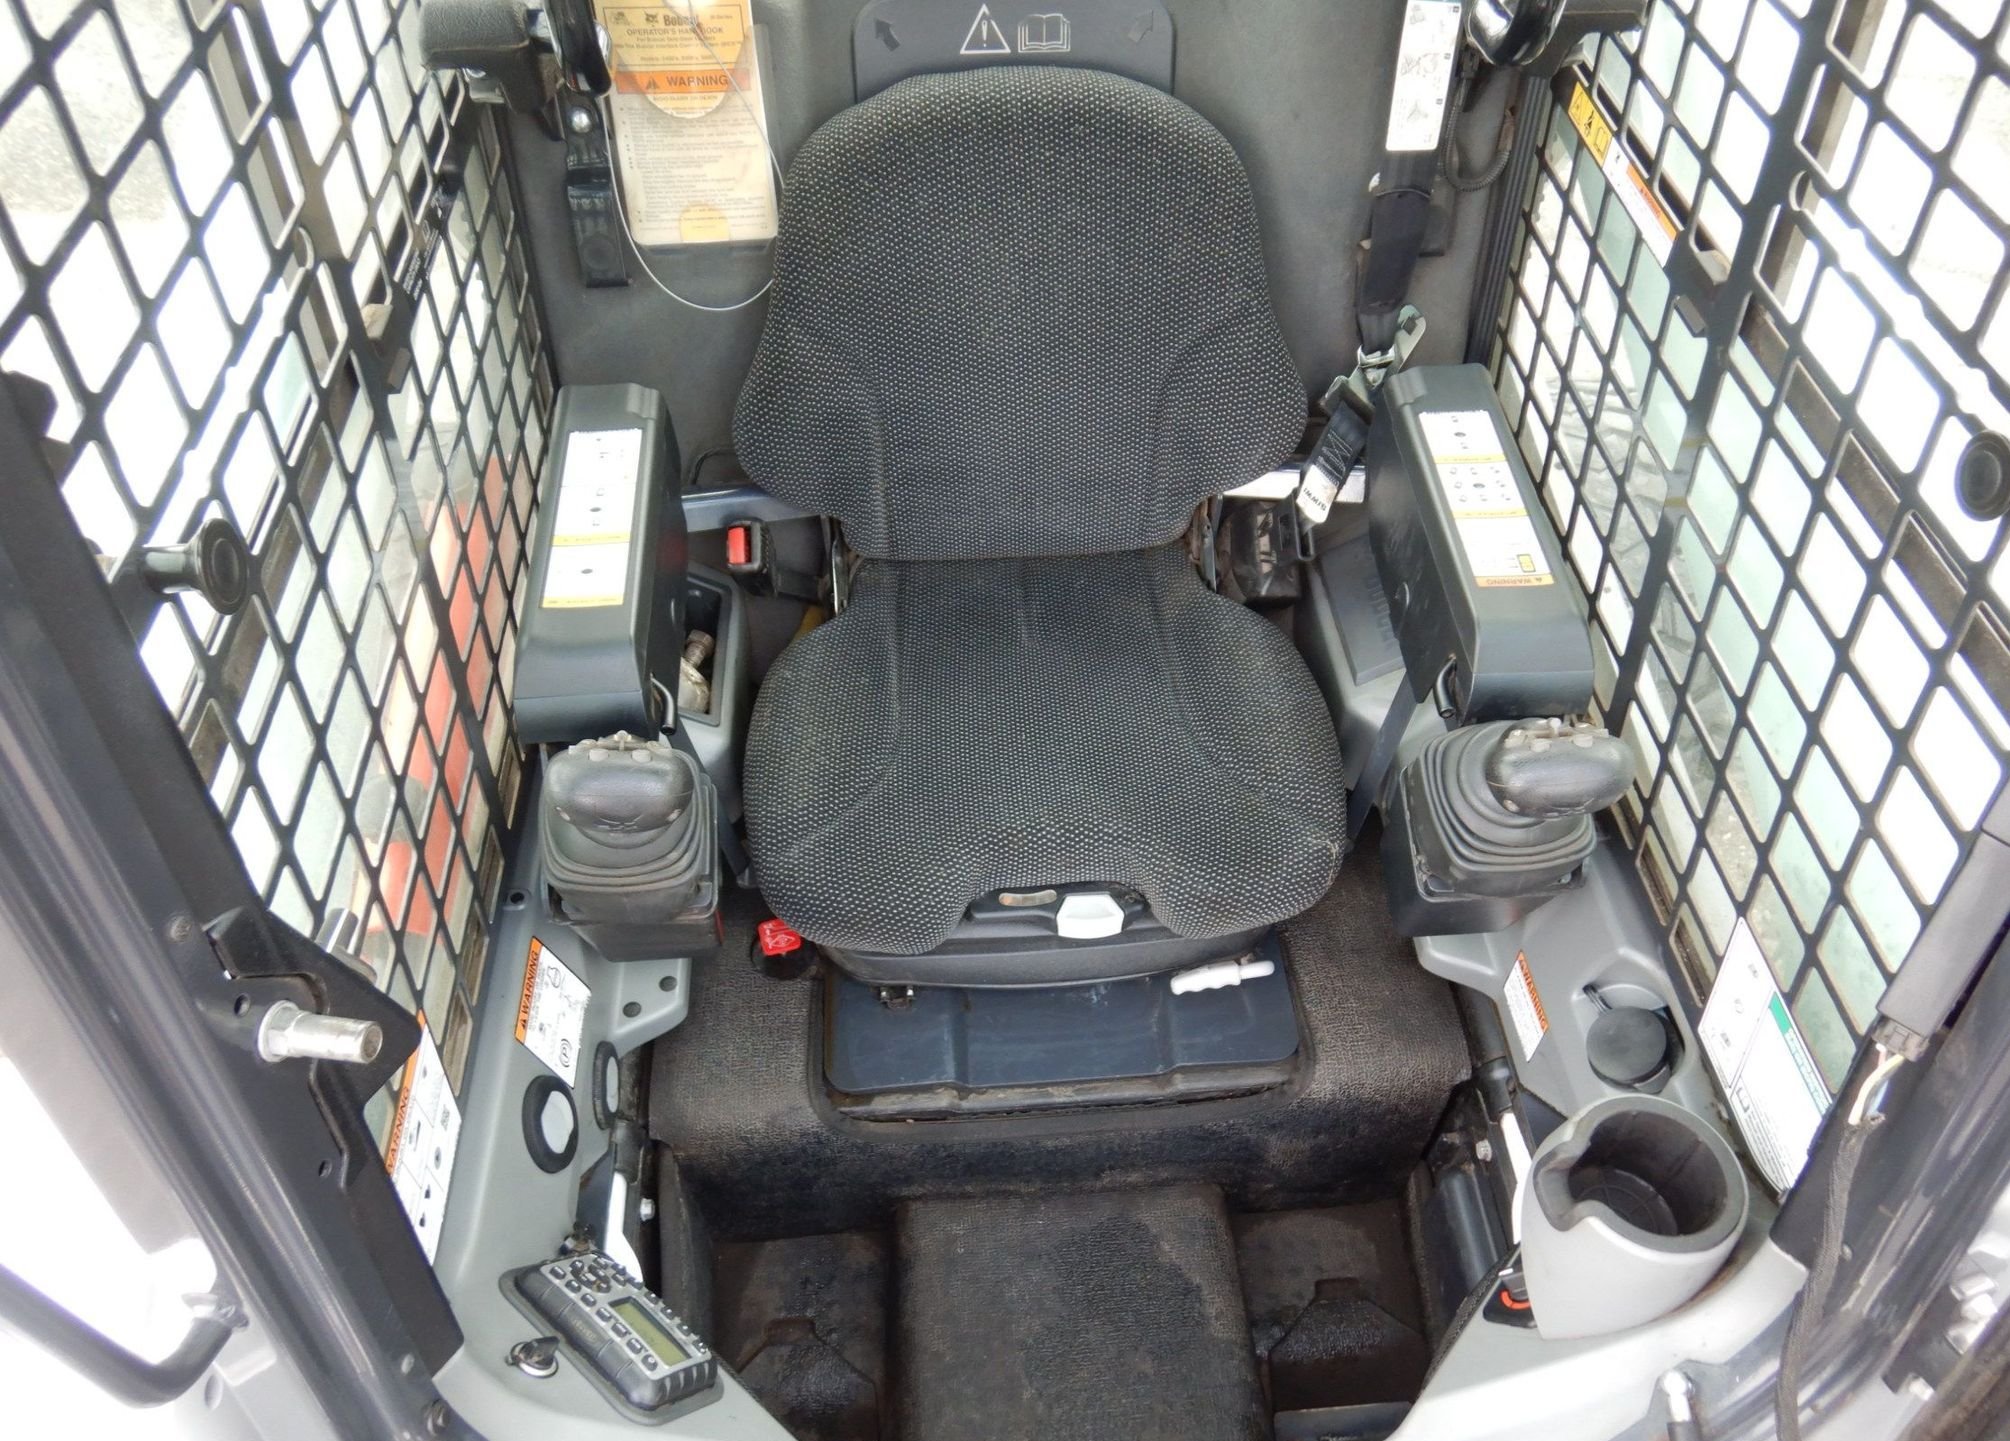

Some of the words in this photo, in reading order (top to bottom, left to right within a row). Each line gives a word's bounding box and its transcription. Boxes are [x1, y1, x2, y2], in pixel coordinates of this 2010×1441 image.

[679, 26, 724, 34] HANOOK
[666, 75, 728, 88] WARNING
[522, 950, 539, 1015] WARNING
